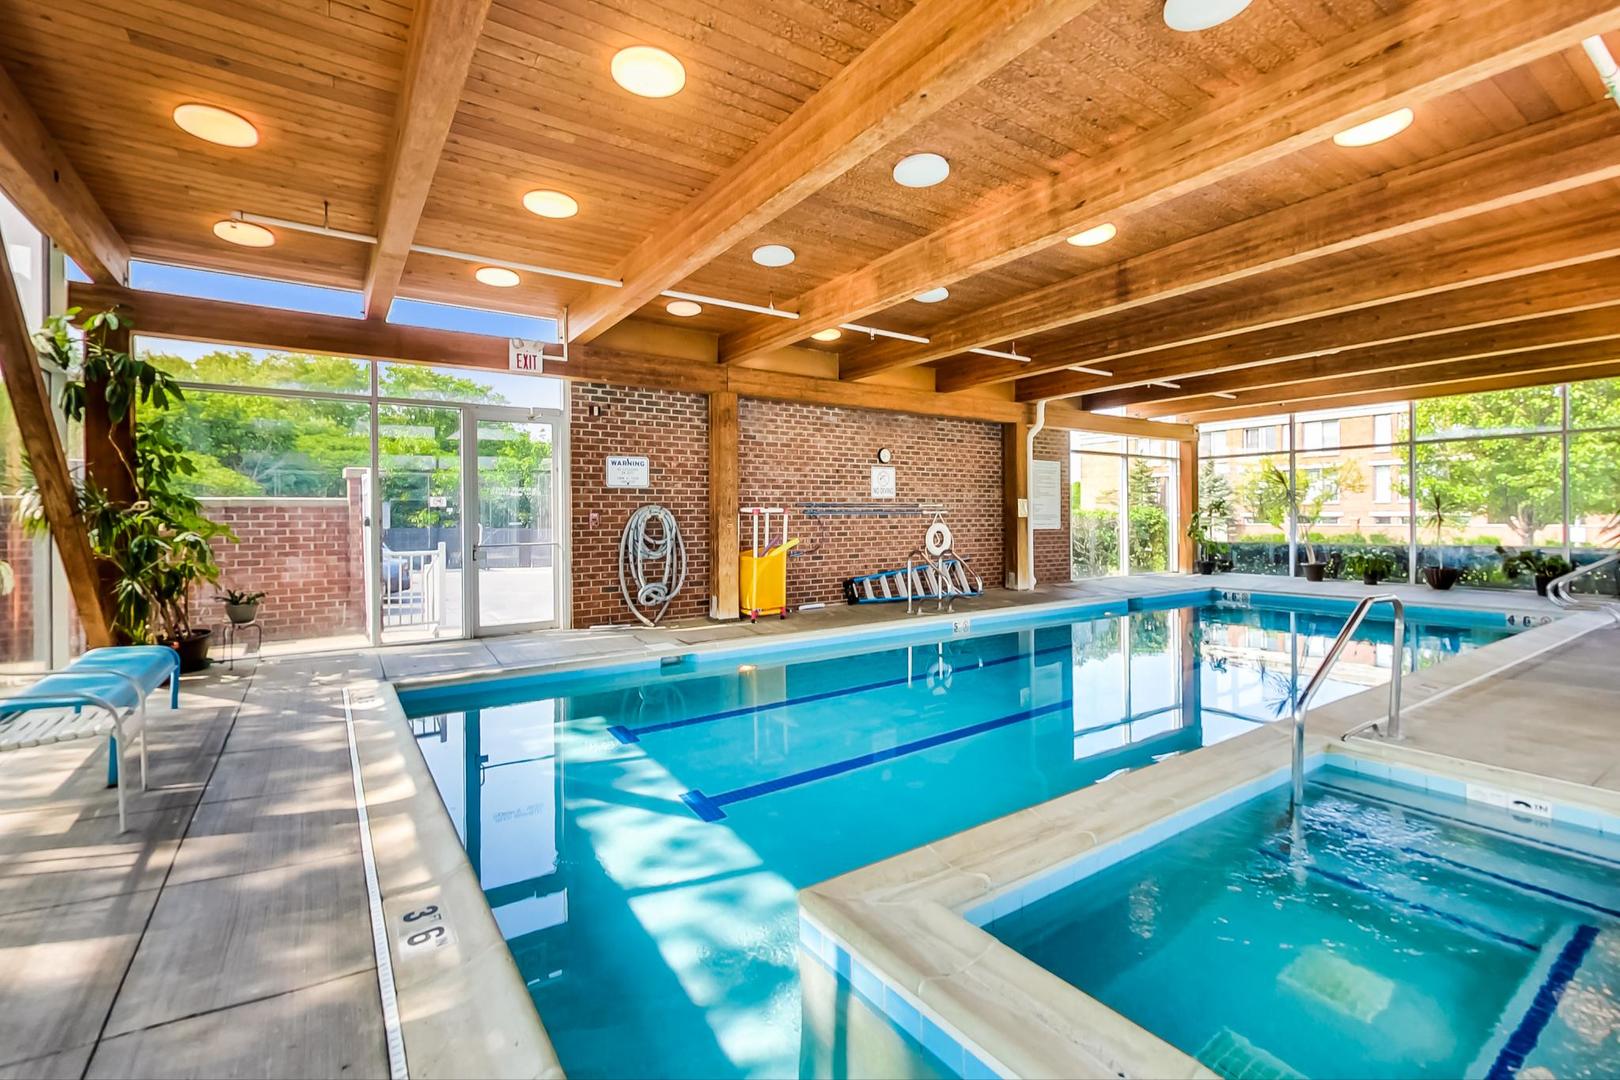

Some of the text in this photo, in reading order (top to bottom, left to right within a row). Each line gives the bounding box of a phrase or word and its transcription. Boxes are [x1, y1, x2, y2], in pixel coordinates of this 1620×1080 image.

[516, 353, 537, 370] EXIT
[403, 905, 439, 922] 3
[407, 926, 445, 946] 6
